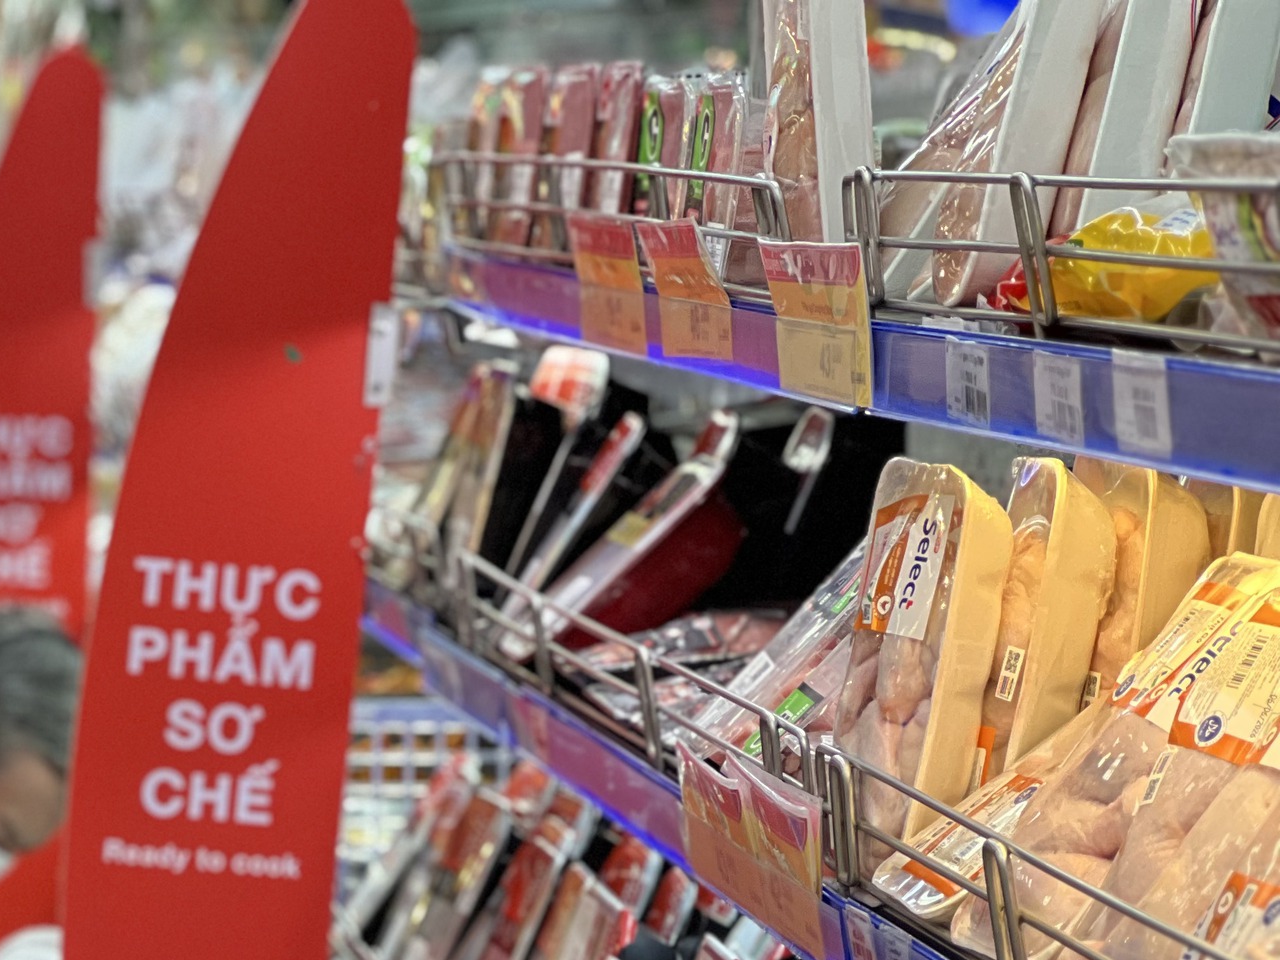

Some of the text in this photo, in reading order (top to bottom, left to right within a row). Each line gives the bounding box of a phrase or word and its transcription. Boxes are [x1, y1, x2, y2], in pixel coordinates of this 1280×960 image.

[133, 554, 322, 622] THỰC
[899, 518, 937, 609] Select
[126, 618, 316, 691] PHẨM
[164, 699, 266, 755] SƠ
[139, 758, 281, 826] CHẾ
[101, 837, 301, 880] Ready to cook
